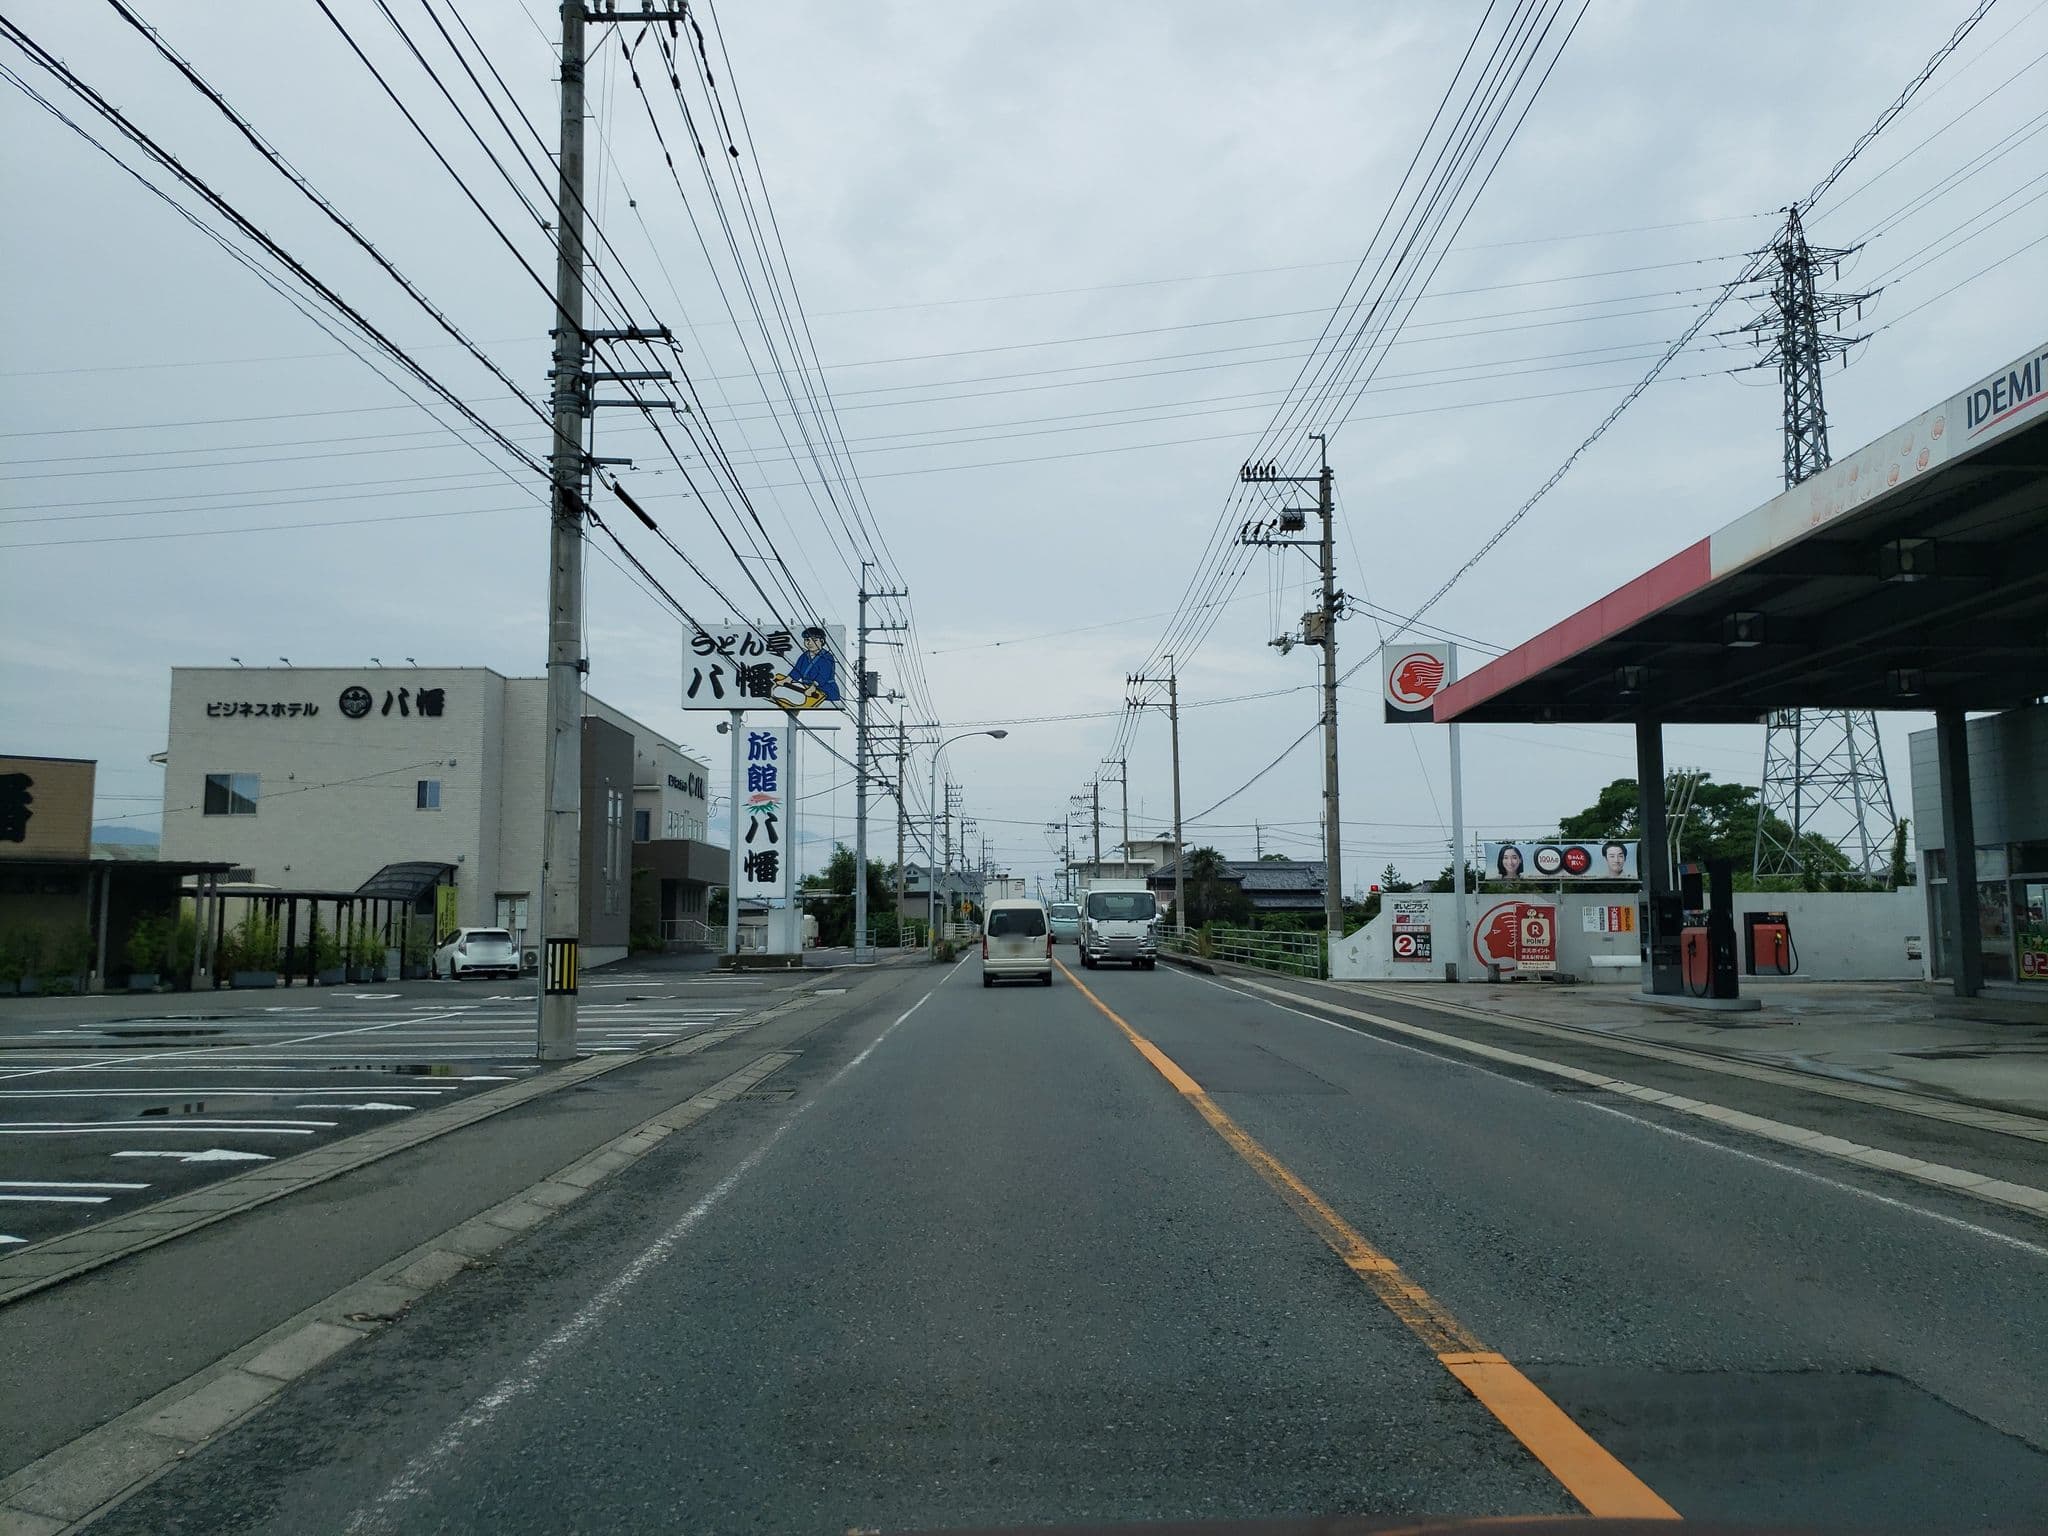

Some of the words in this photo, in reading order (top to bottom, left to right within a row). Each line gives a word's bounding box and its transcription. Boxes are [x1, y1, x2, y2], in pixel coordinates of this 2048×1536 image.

[1967, 352, 2048, 430] IDEMI
[691, 631, 793, 657] うどん亭
[687, 662, 775, 699] 八幡
[207, 702, 319, 717] ビジネスホテル
[381, 687, 445, 717] 八幡
[747, 731, 778, 792] 旅館
[744, 812, 779, 883] 八幡
[1531, 924, 1540, 935] R
[1399, 937, 1412, 953] 2
